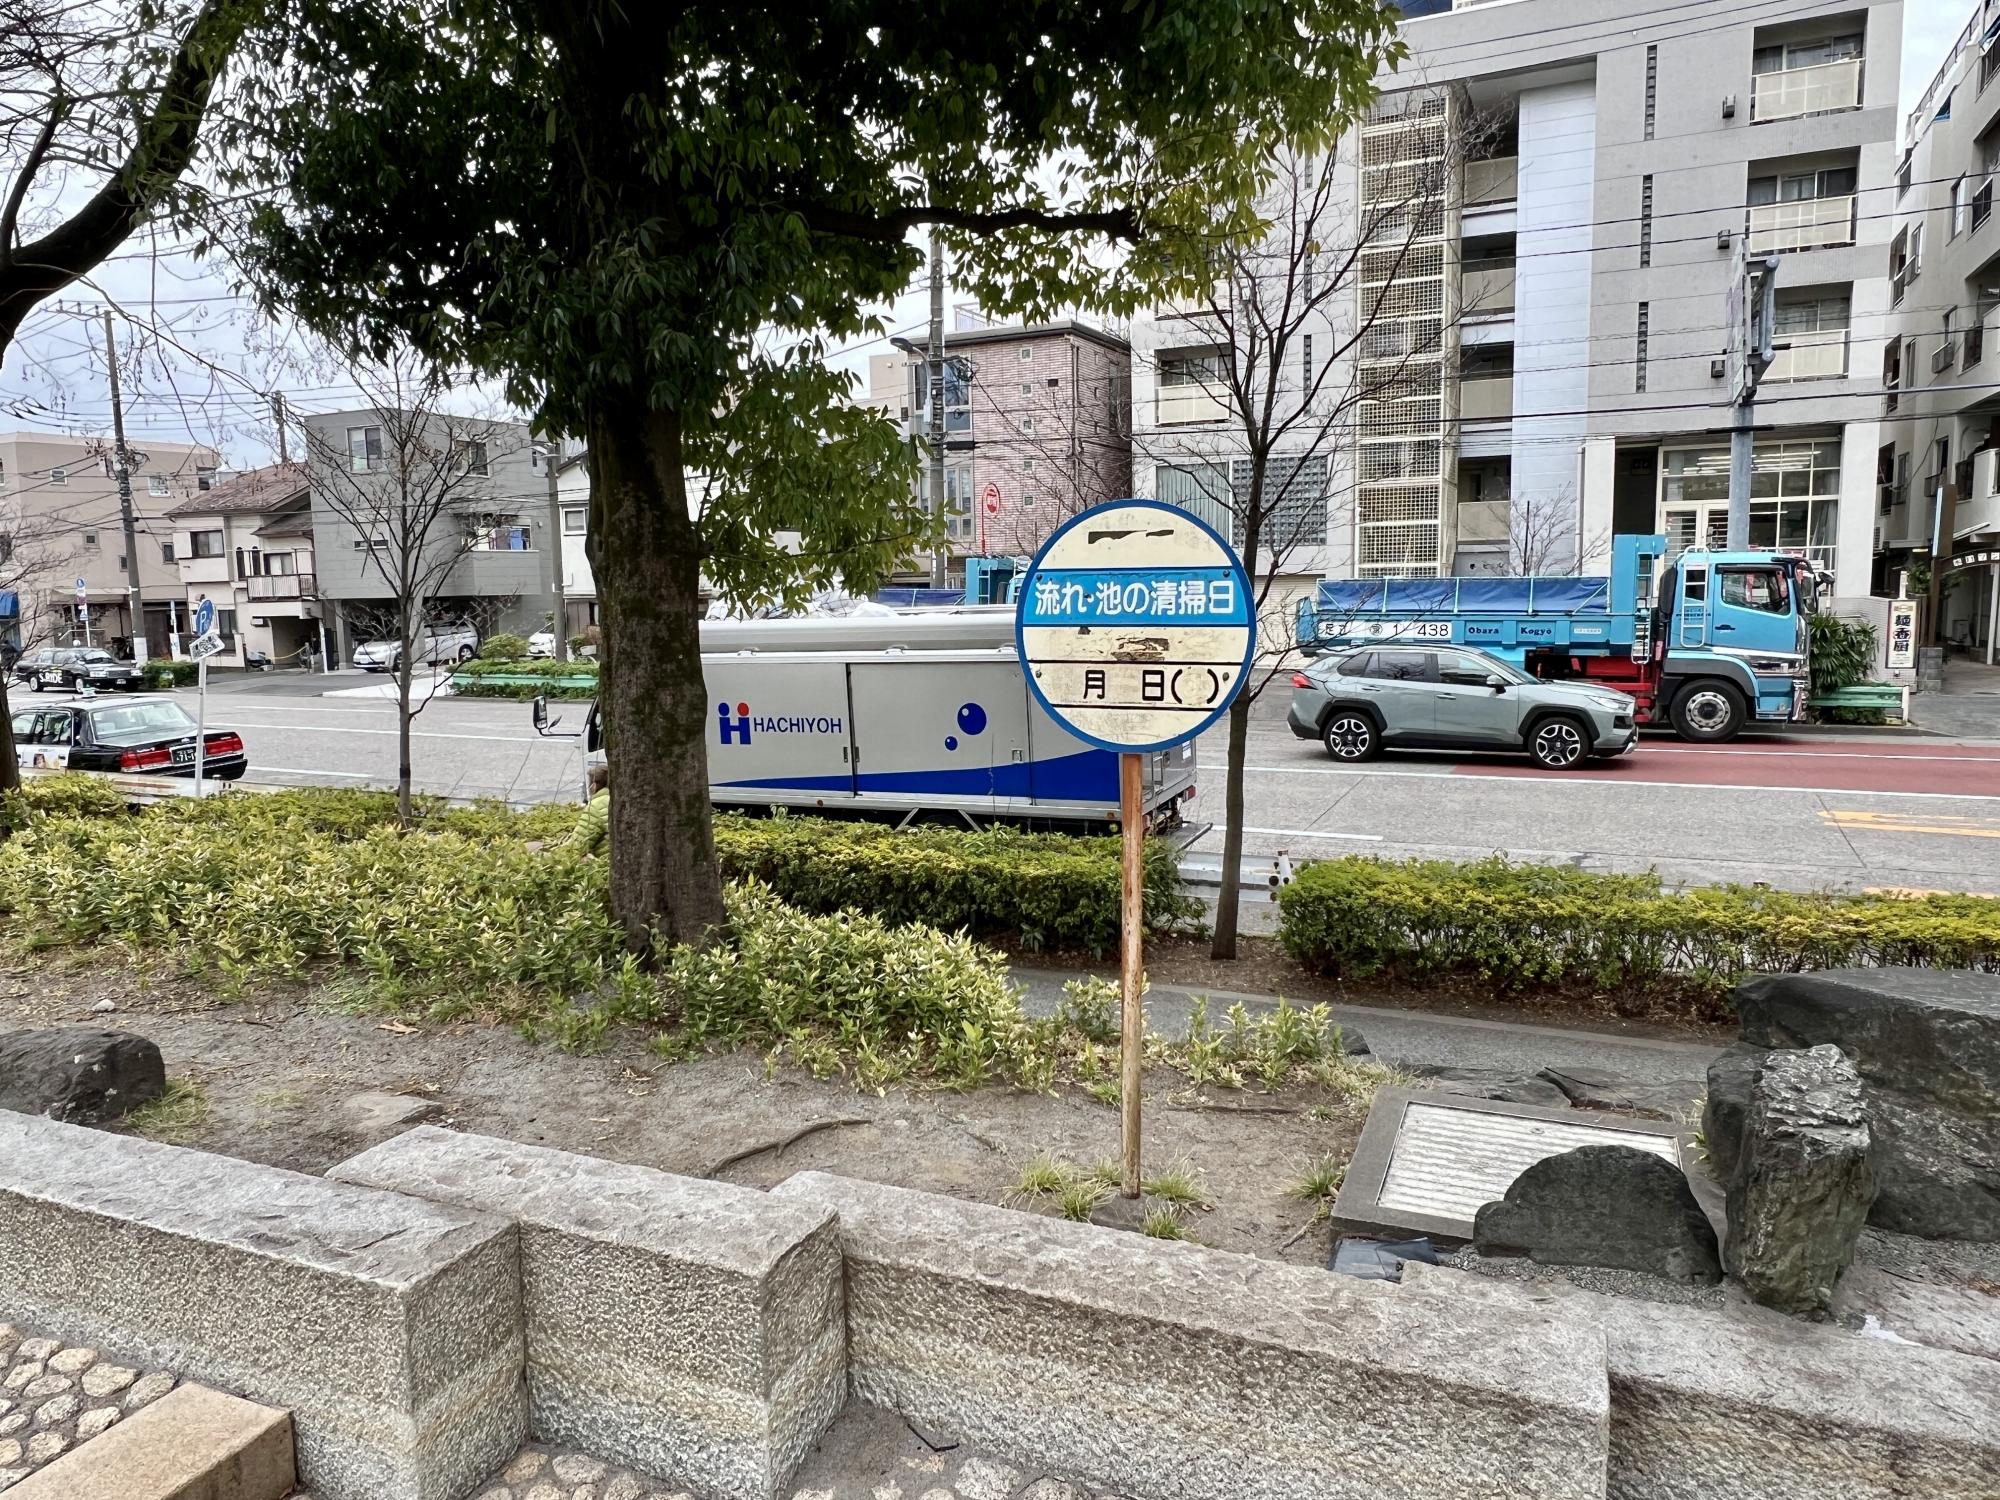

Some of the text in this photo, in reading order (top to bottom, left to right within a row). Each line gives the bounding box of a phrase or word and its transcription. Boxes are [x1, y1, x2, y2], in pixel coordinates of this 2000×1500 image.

[1035, 580, 1234, 616] 流れ・池の清掃日
[1417, 624, 1449, 636] 438
[1468, 626, 1499, 635] Obara
[1083, 669, 1106, 699] 月
[753, 717, 842, 733] HACHIYOH
